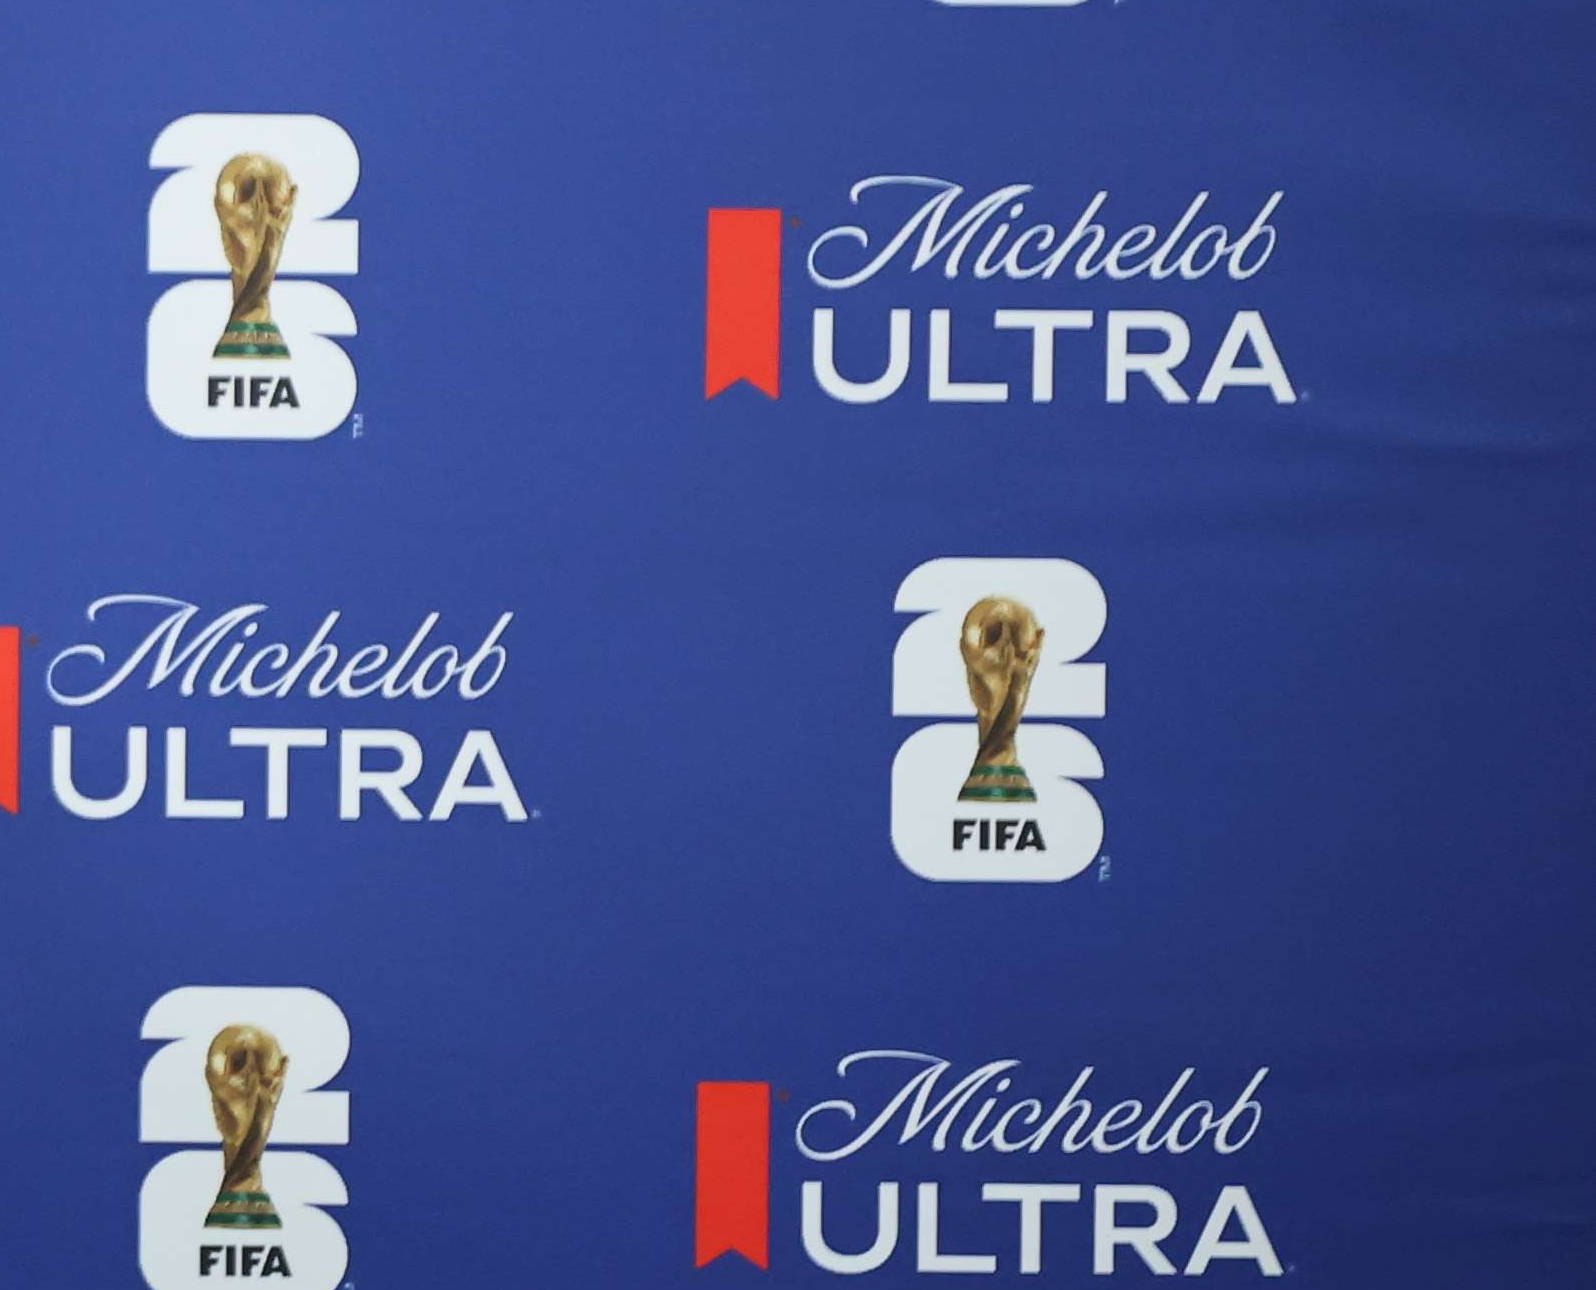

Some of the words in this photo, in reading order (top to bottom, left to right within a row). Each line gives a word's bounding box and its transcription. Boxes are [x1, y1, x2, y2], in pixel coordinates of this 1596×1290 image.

[807, 175, 1284, 289] Michelob
[207, 376, 300, 408] FIFA
[812, 308, 1297, 404] ULTRA
[46, 593, 514, 707] Michelob
[51, 725, 528, 822] ULTRA
[952, 819, 1046, 852] FIFA
[795, 1049, 1269, 1162] Michelob
[199, 1245, 292, 1278] FIFA
[801, 1180, 1284, 1277] ULTRA
